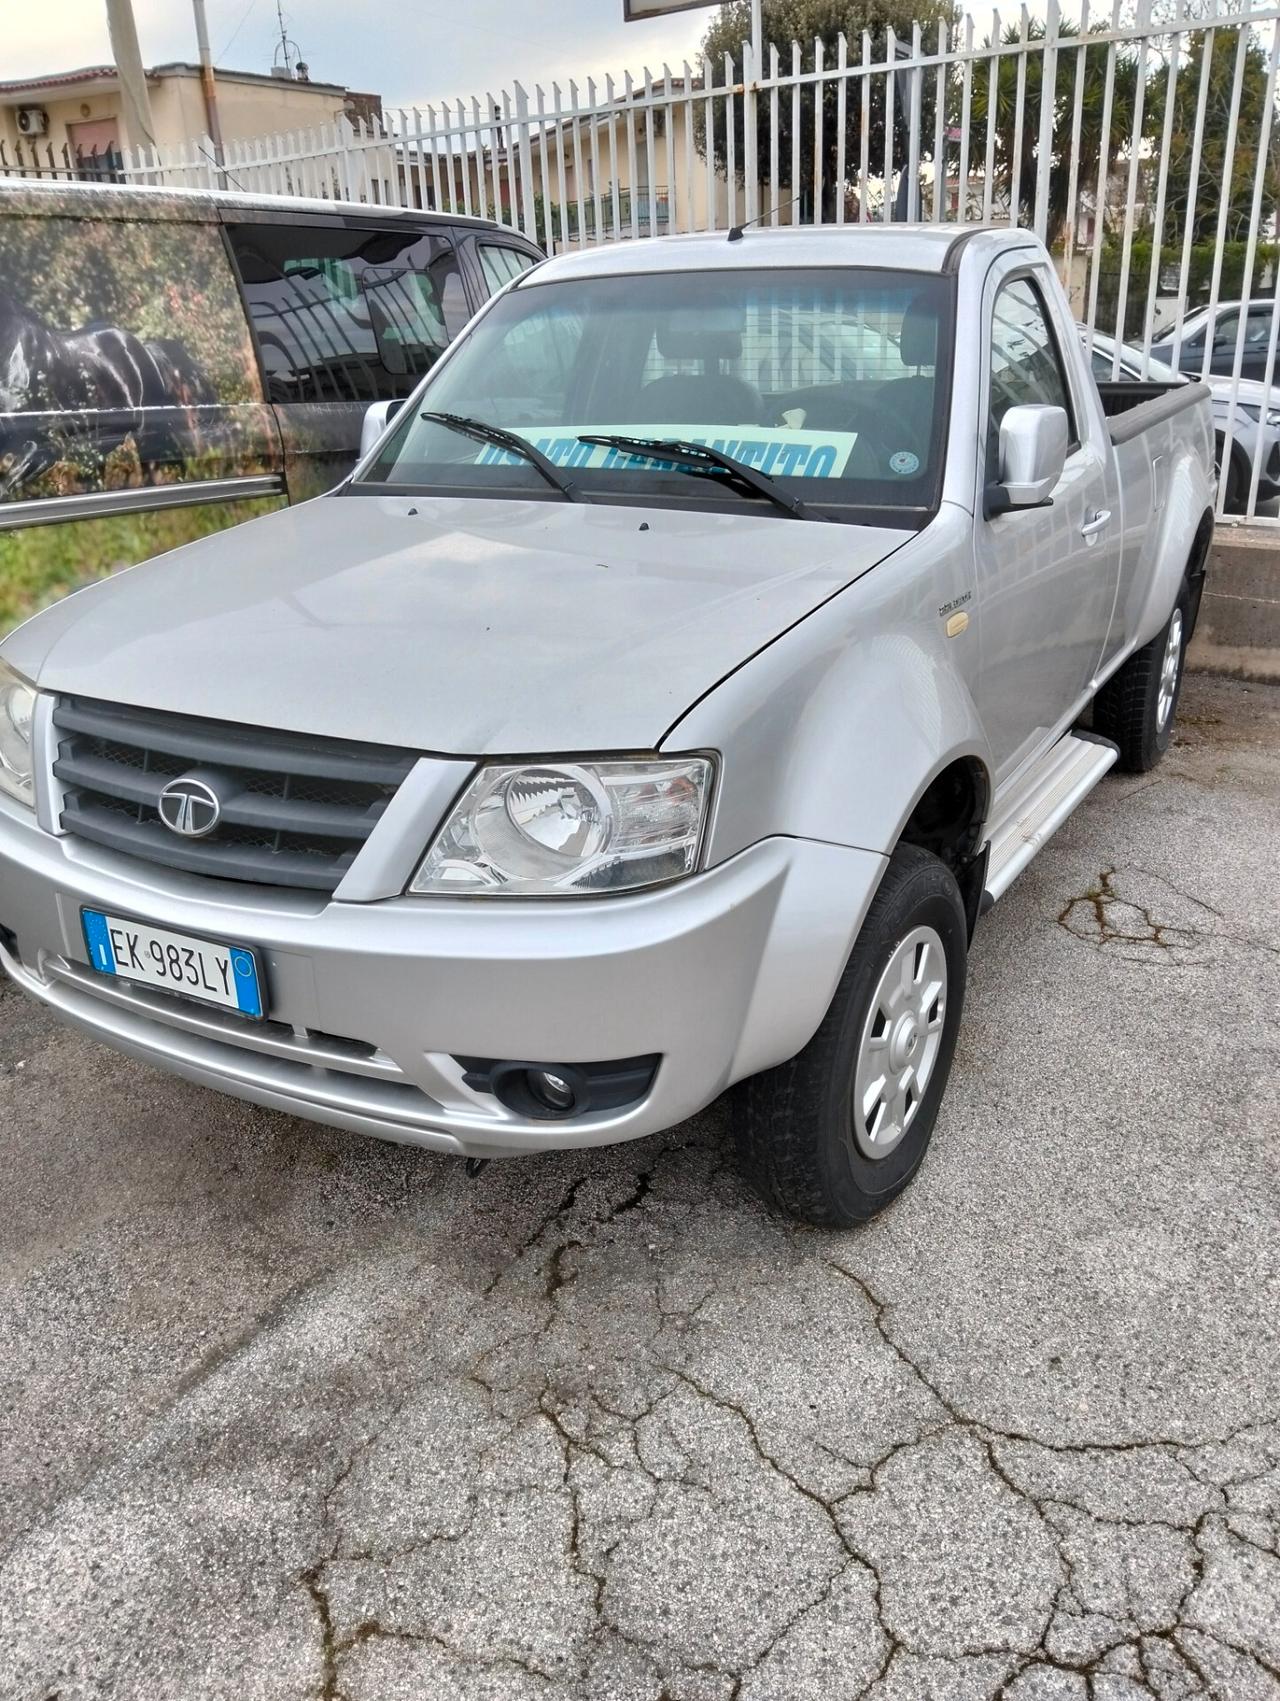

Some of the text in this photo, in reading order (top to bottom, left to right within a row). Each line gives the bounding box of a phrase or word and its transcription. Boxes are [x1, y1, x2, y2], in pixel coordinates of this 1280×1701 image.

[600, 438, 838, 478] GNTITO
[109, 927, 230, 996] EK 983LY
